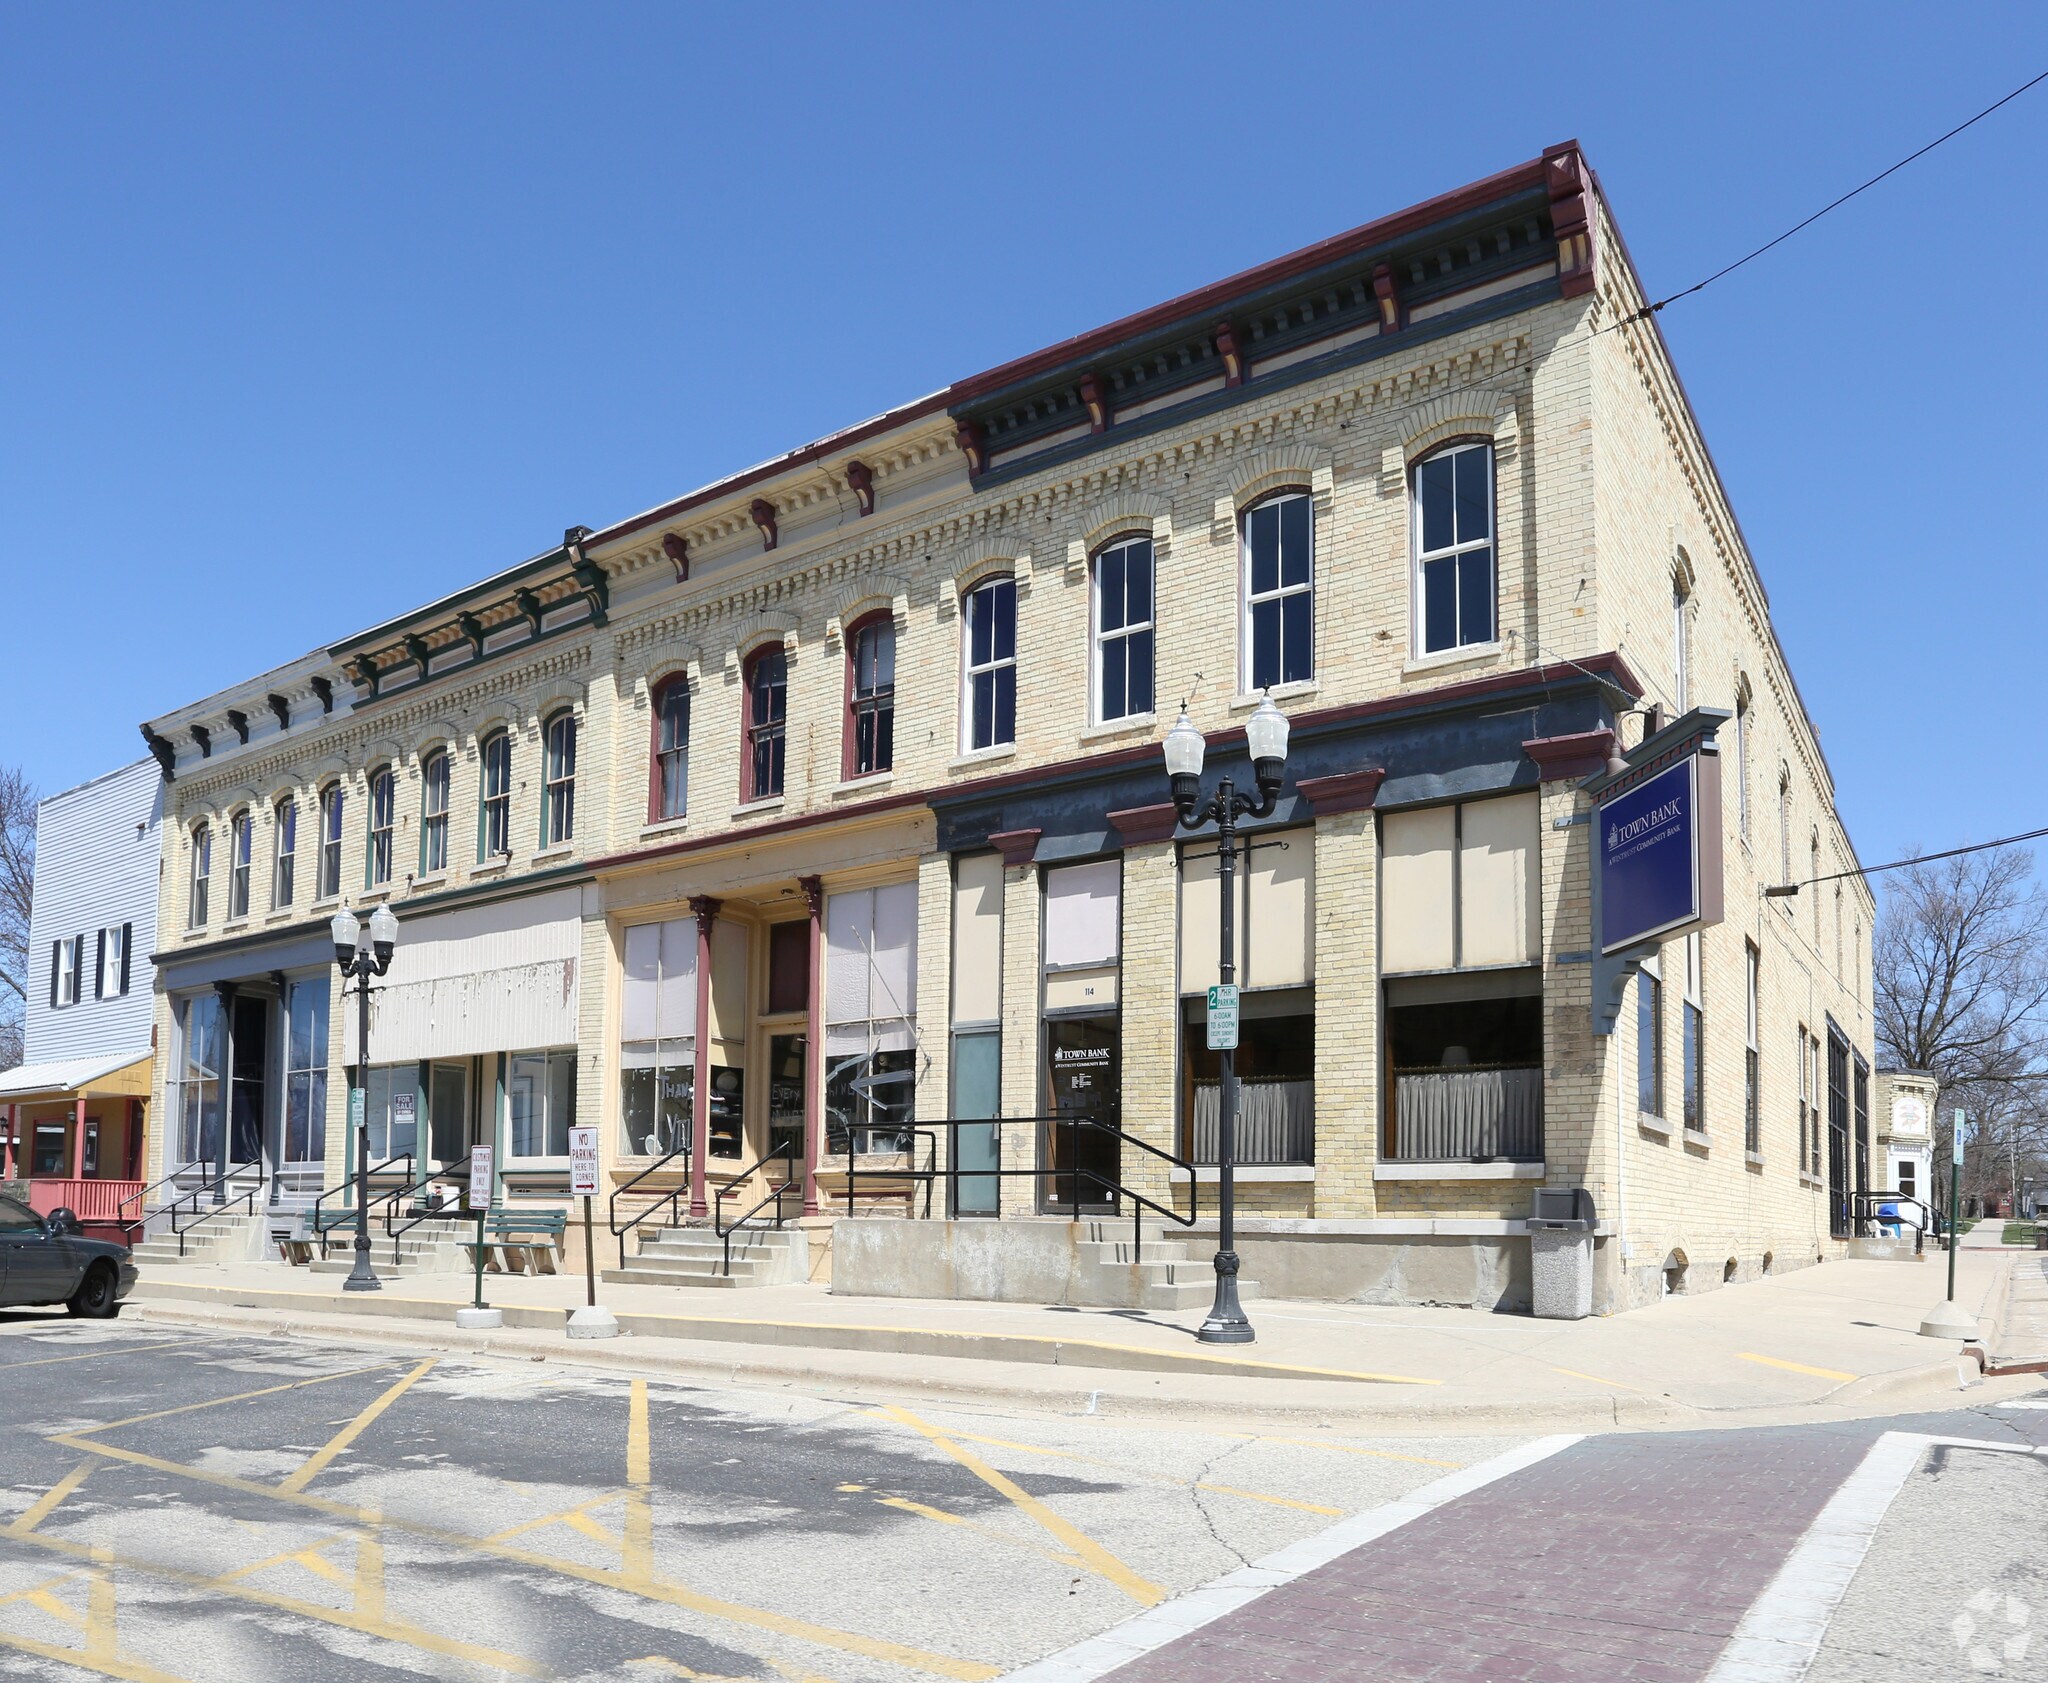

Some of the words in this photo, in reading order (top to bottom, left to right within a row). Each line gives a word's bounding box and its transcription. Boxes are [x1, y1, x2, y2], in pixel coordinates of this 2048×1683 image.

[1618, 814, 1649, 842] TOWN
[1651, 797, 1682, 824] BANK
[1636, 830, 1666, 852] COMMUNITY
[1666, 824, 1681, 836] BANK
[1085, 988, 1094, 996] 114
[1210, 990, 1216, 1006] 2
[1218, 998, 1236, 1006] PARKING
[1064, 1049, 1088, 1059] TOWN
[1088, 1048, 1110, 1058] BANK
[578, 1134, 588, 1146] NO
[572, 1148, 596, 1161] PARKING
[474, 1164, 488, 1174] PARKING
[575, 1162, 587, 1172] HERE
[588, 1162, 594, 1171] TO
[476, 1176, 485, 1186] ONLY
[576, 1172, 594, 1182] CORNER
